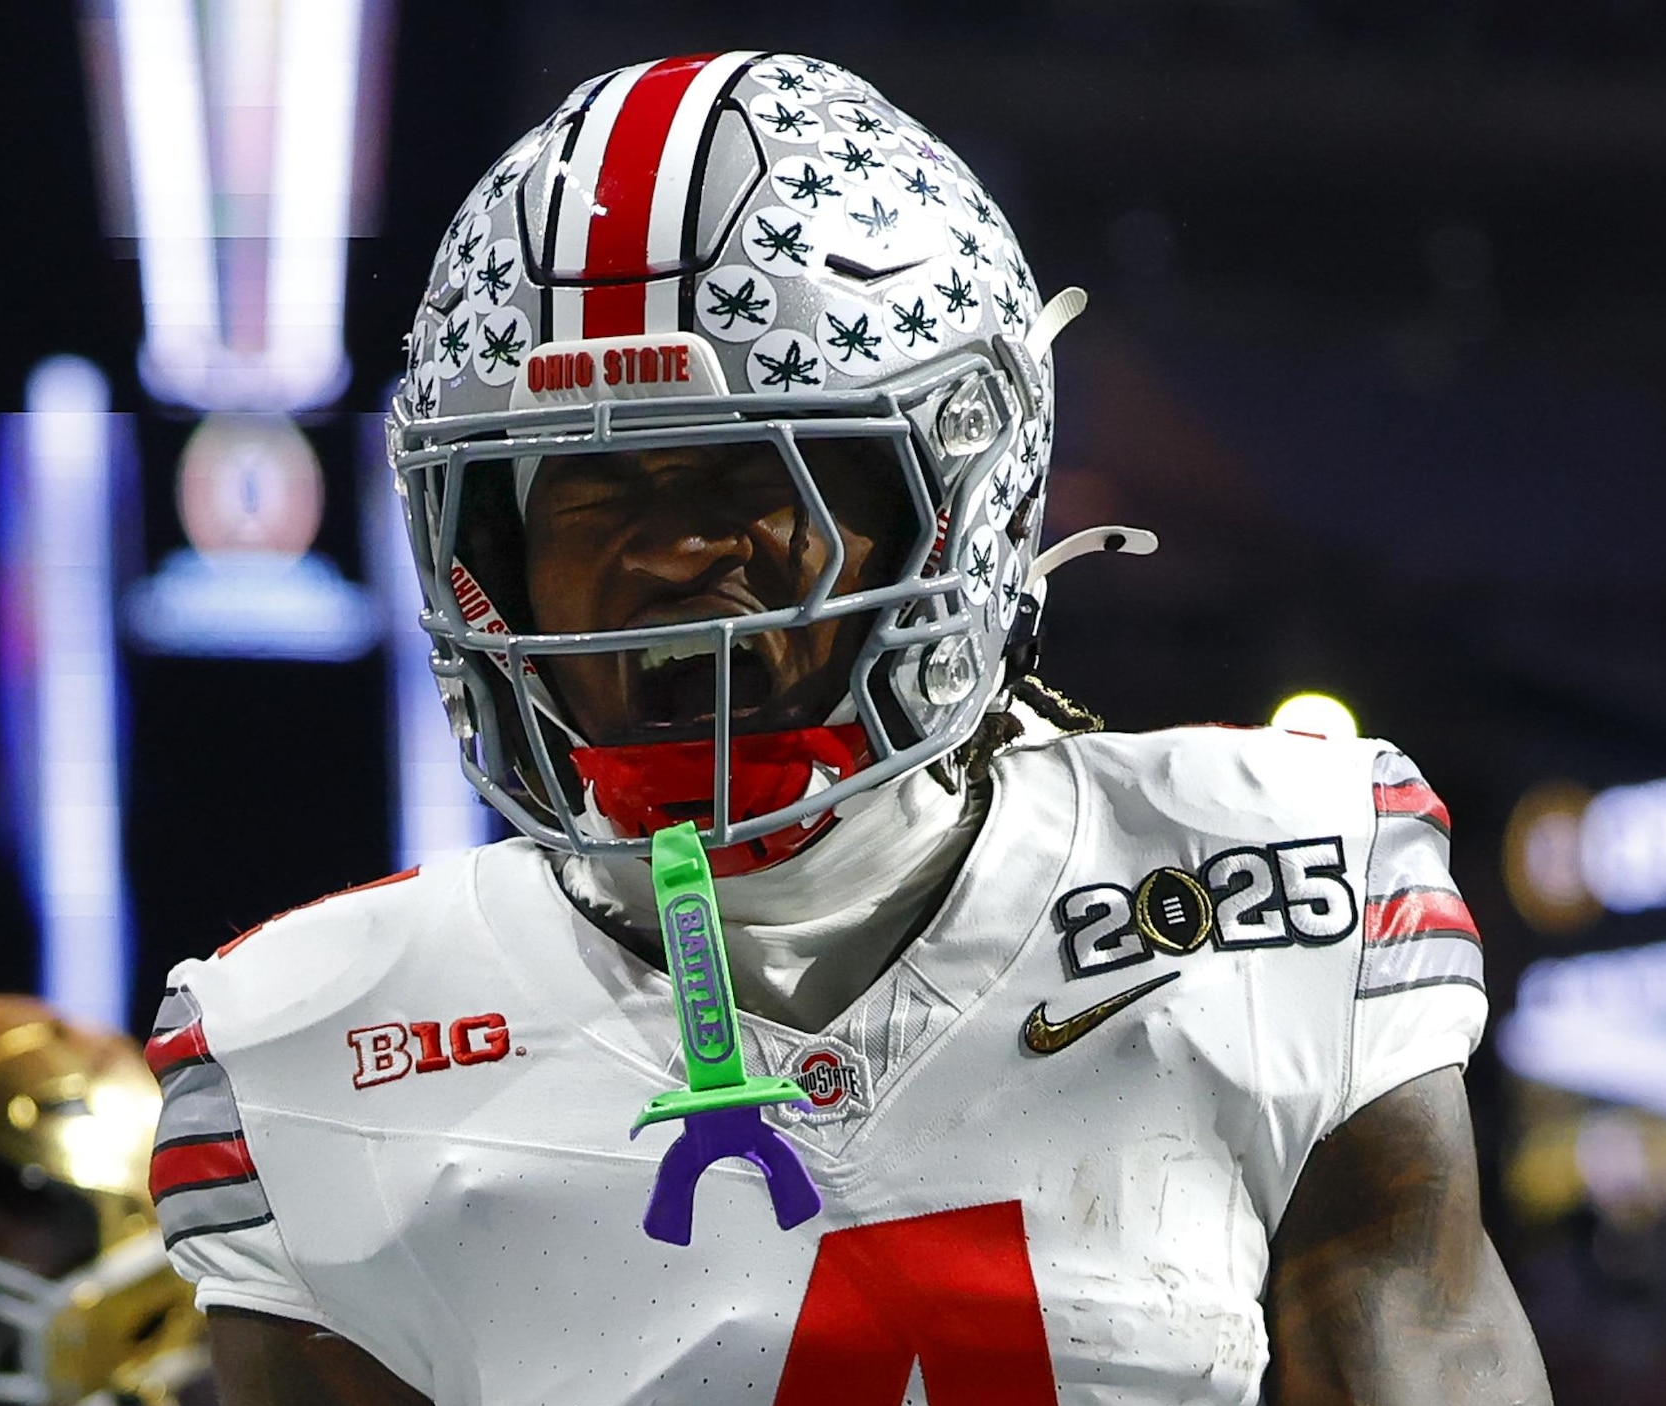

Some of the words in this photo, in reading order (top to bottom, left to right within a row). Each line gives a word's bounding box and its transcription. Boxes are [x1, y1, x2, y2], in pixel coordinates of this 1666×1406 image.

[527, 353, 594, 393] OHIO
[603, 345, 690, 386] STATE
[675, 908, 725, 1048] BATTLE
[1053, 836, 1359, 980] 2025
